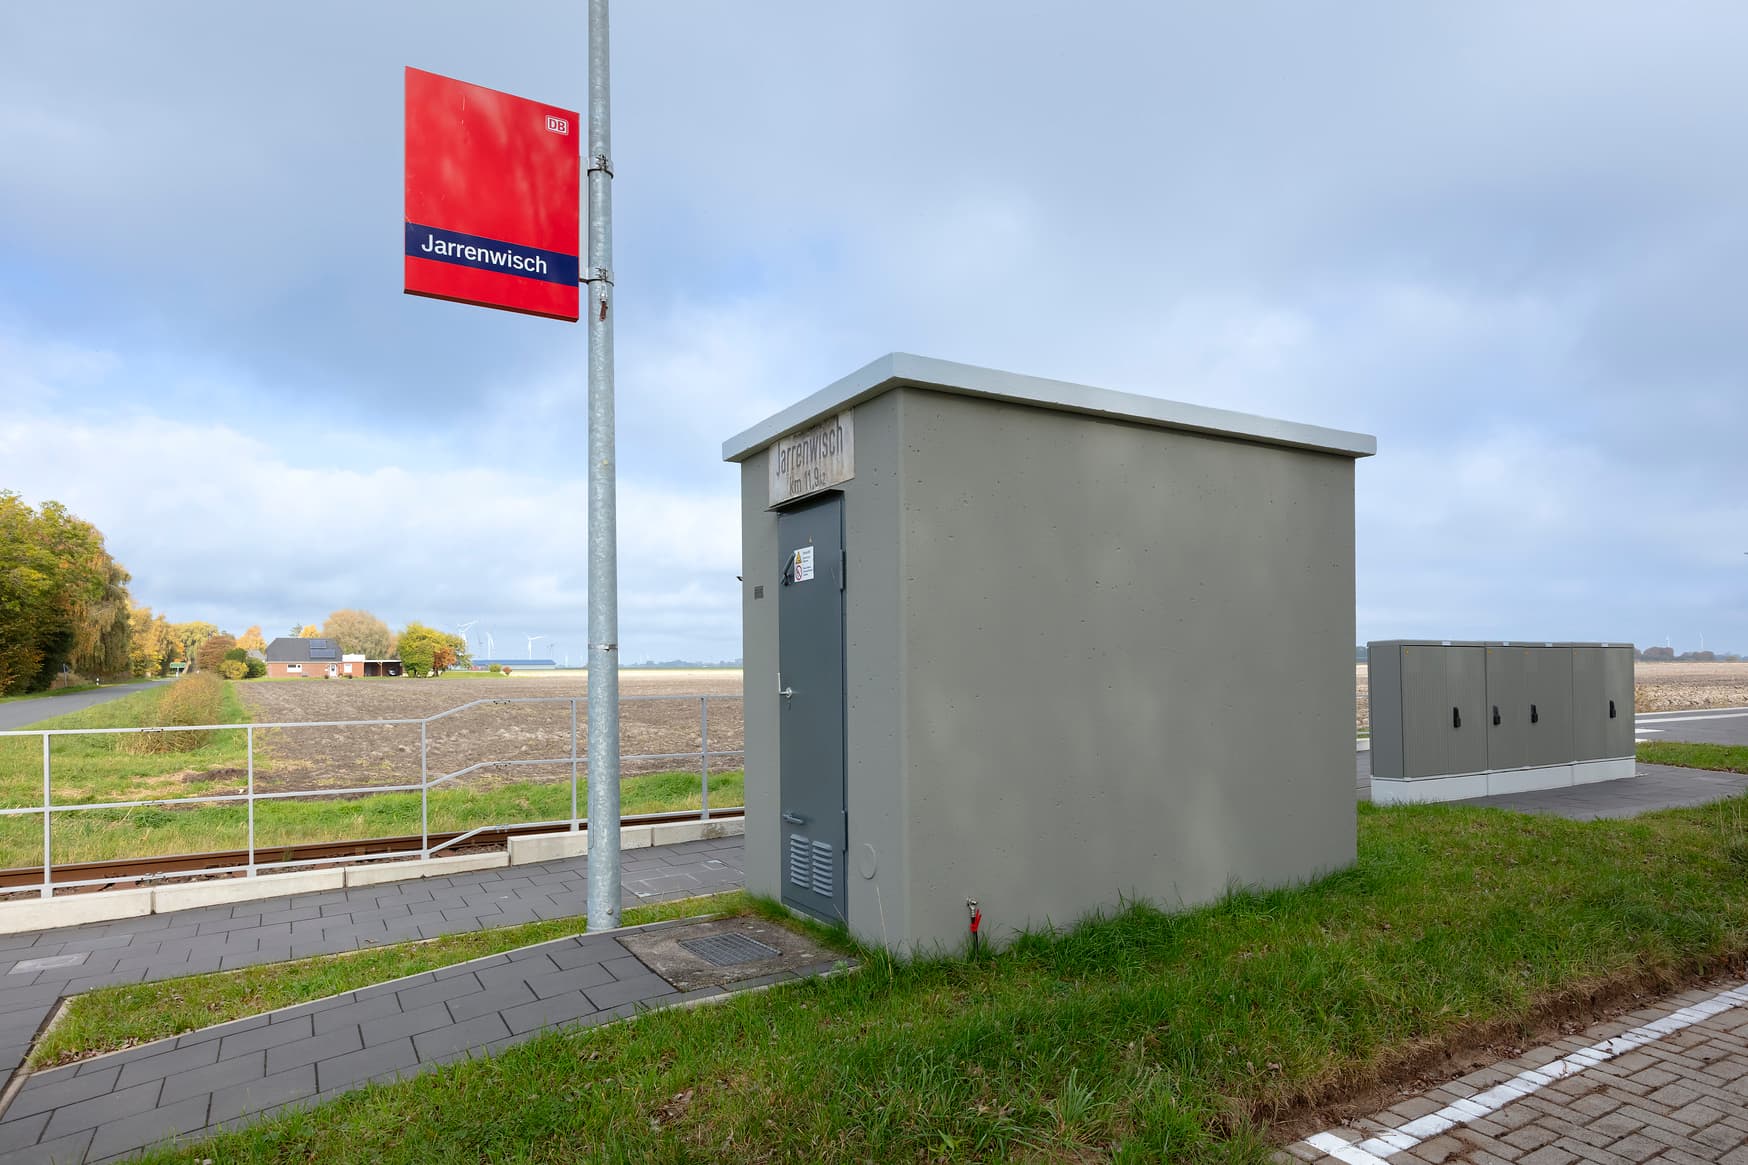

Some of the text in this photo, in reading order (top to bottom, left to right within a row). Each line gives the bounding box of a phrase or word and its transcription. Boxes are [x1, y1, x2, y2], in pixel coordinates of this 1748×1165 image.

[547, 117, 567, 132] DB
[421, 234, 547, 275] Jarrenwisch
[776, 414, 843, 477] Jarrenwisch
[789, 475, 802, 496] km
